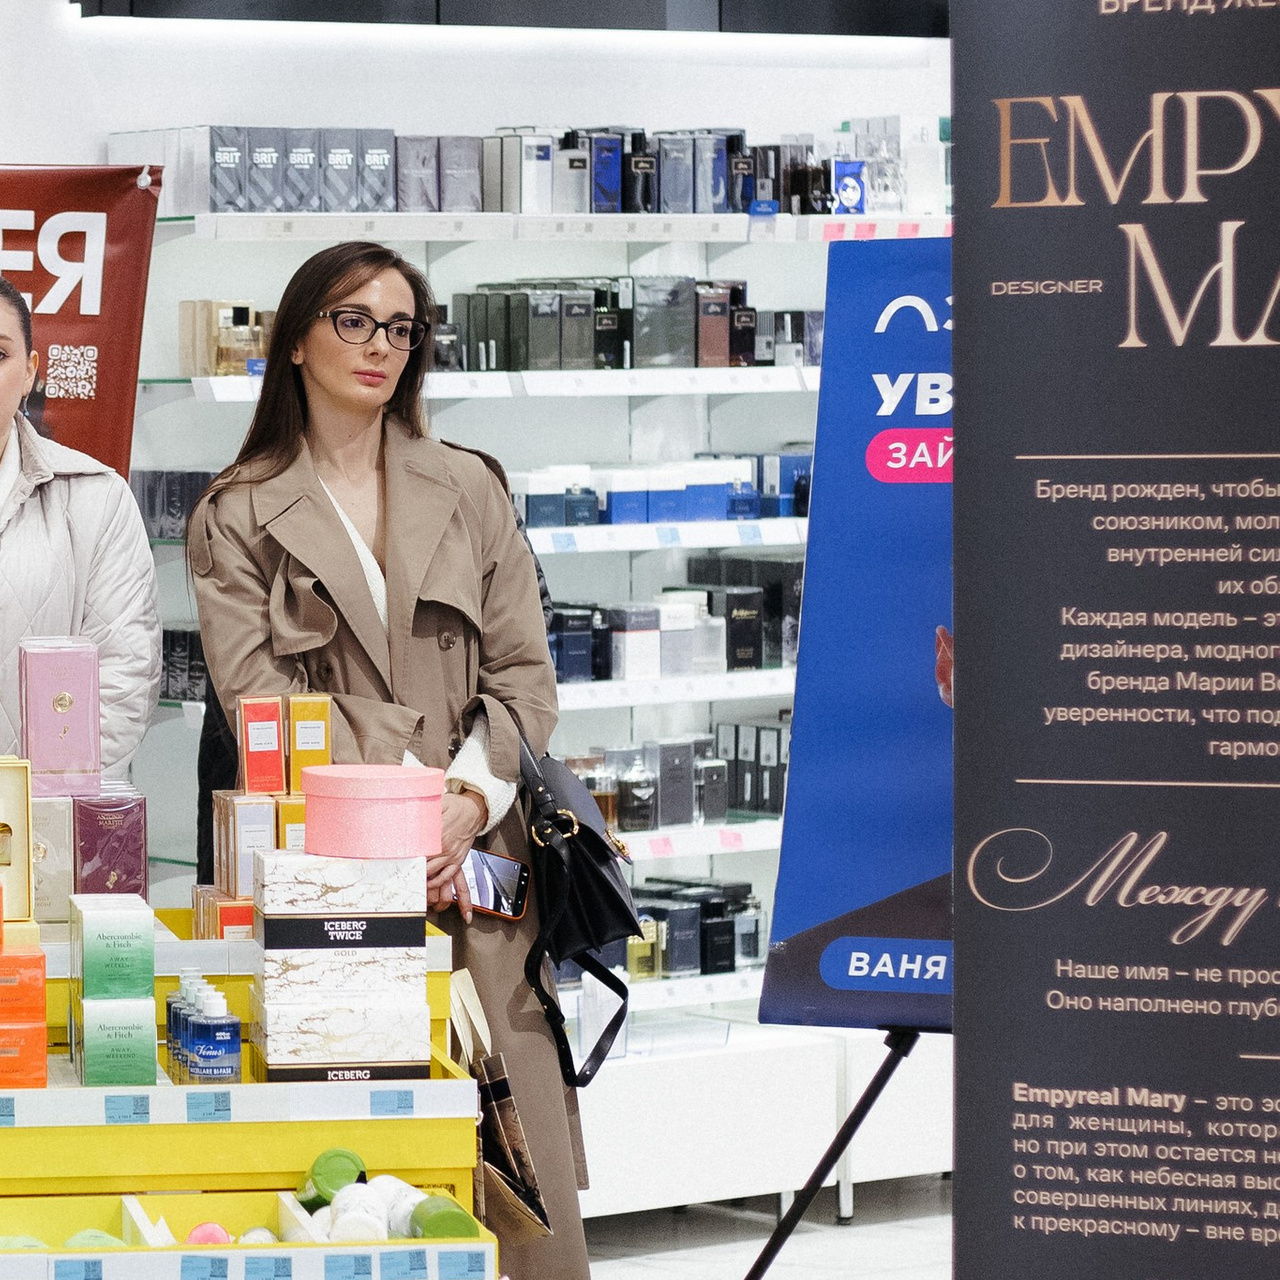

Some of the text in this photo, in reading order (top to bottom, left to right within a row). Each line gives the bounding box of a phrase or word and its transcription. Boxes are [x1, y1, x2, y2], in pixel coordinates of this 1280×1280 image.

[215, 151, 241, 164] BRIT
[253, 152, 278, 165] BRIT
[289, 151, 316, 165] BRIT
[328, 153, 354, 166] BRIT
[365, 154, 390, 167] BRIT
[991, 280, 1103, 295] DESIGNER
[1036, 479, 1108, 503] Бренд
[1112, 483, 1206, 503] рожден,
[1092, 515, 1229, 533] союзником,
[1107, 543, 1243, 567] внутренней
[1218, 575, 1279, 595] их об
[1061, 606, 1147, 629] Каждая
[1153, 612, 1238, 629] модель
[1059, 639, 1189, 663] дизайнера,
[1087, 670, 1170, 695] бренда
[1175, 671, 1254, 696] Марии
[1043, 706, 1196, 726] уверенности,
[1201, 708, 1241, 724] что
[967, 828, 1269, 946] Между
[324, 921, 367, 931] ICEBERG
[328, 931, 363, 941] TWICE
[114, 940, 131, 948] Fitch
[848, 951, 947, 980] ВАНЯ
[1056, 958, 1120, 980] Наше
[1125, 966, 1169, 981] имя
[1195, 968, 1223, 983] не
[1046, 989, 1280, 1021] Оно наполнено глуб
[195, 1045, 223, 1057] Venus
[327, 1070, 370, 1080] ICEBERG
[1013, 1082, 1120, 1109] Empyreal
[1126, 1087, 1187, 1113] Mary
[1215, 1096, 1254, 1112] это
[1012, 1113, 1278, 1143] для женщины, котор
[1013, 1139, 1280, 1164] но при этом остается н
[1013, 1164, 1027, 1179] о
[1032, 1164, 1080, 1184] том,
[1086, 1168, 1124, 1183] как
[1130, 1166, 1237, 1188] небесная
[1013, 1189, 1279, 1220] совершенных линиях, д
[1013, 1215, 1026, 1229] к
[1030, 1215, 1181, 1242] прекрасному
[1205, 1225, 1245, 1241] вне
